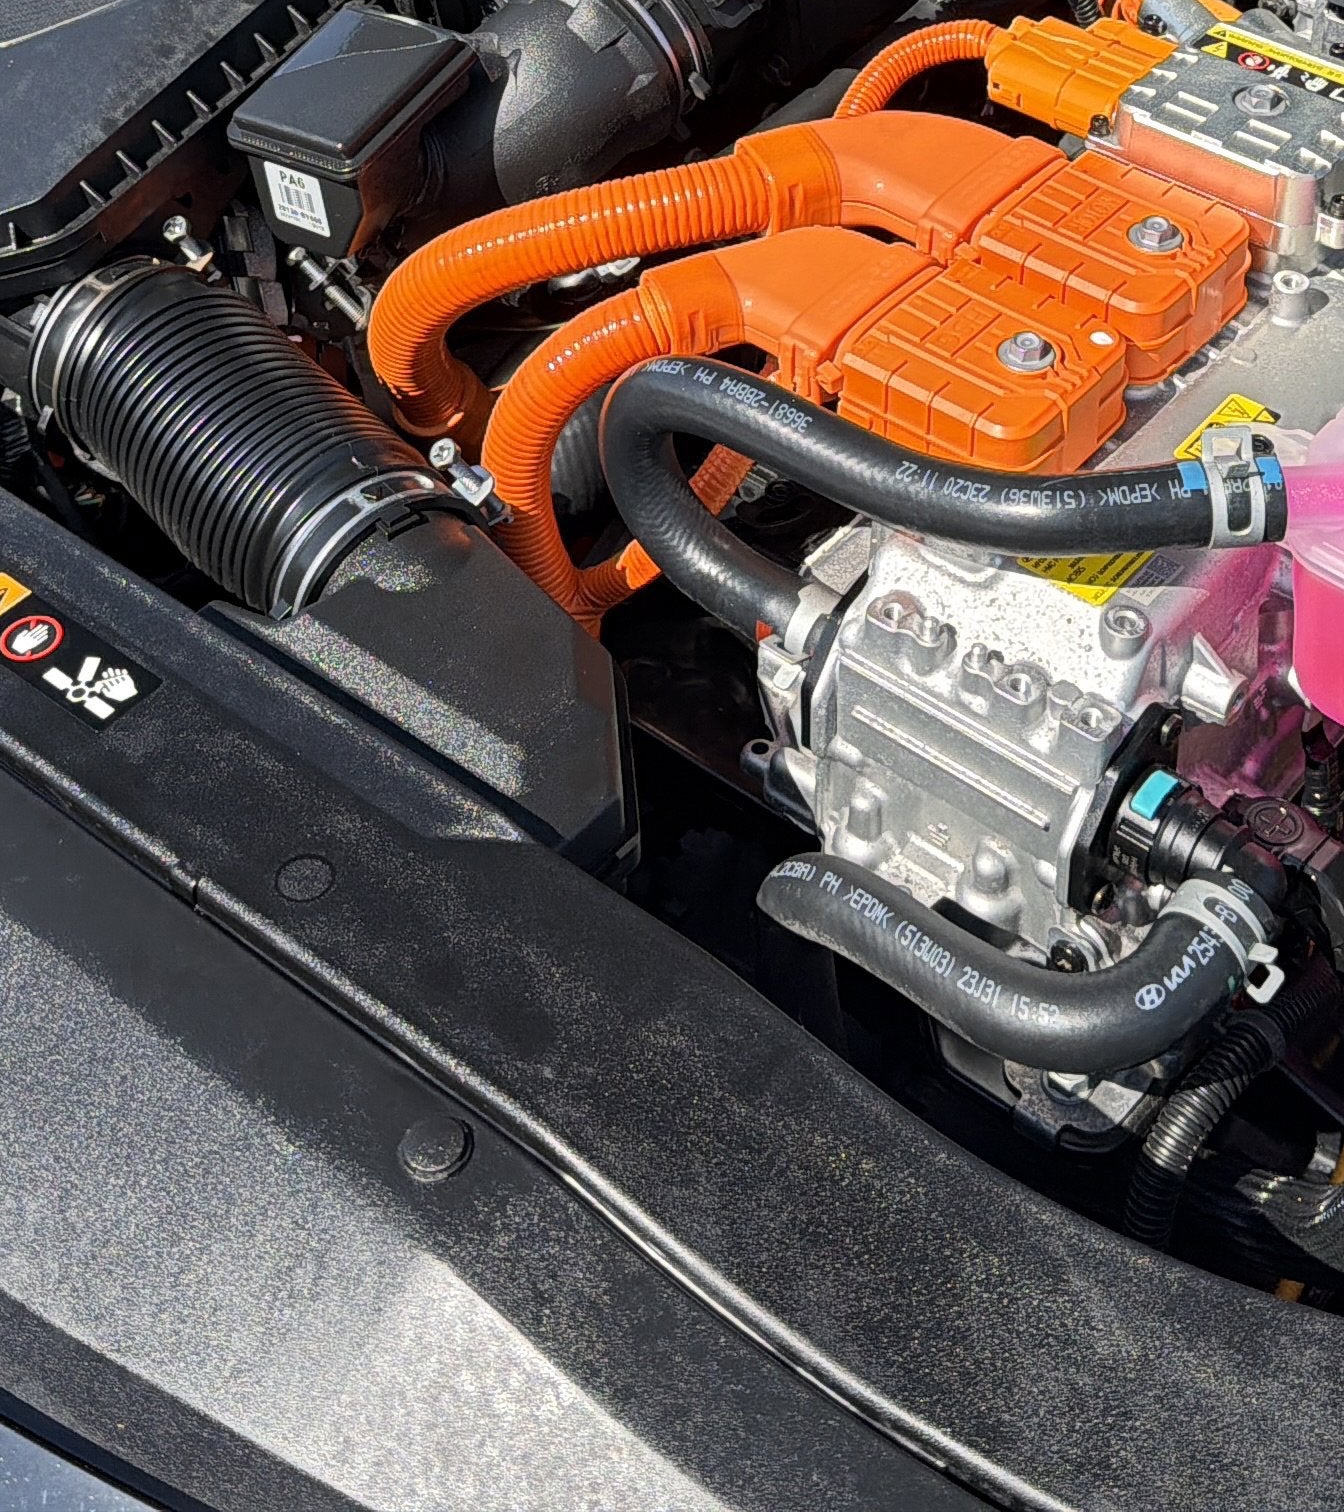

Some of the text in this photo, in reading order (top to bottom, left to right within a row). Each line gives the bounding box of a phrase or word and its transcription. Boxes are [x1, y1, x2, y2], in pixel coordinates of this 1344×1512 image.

[690, 364, 712, 387] PH
[940, 471, 988, 502] 23C20
[1167, 477, 1191, 501] PH
[819, 870, 844, 897] PH
[842, 884, 896, 930] >EPDM<
